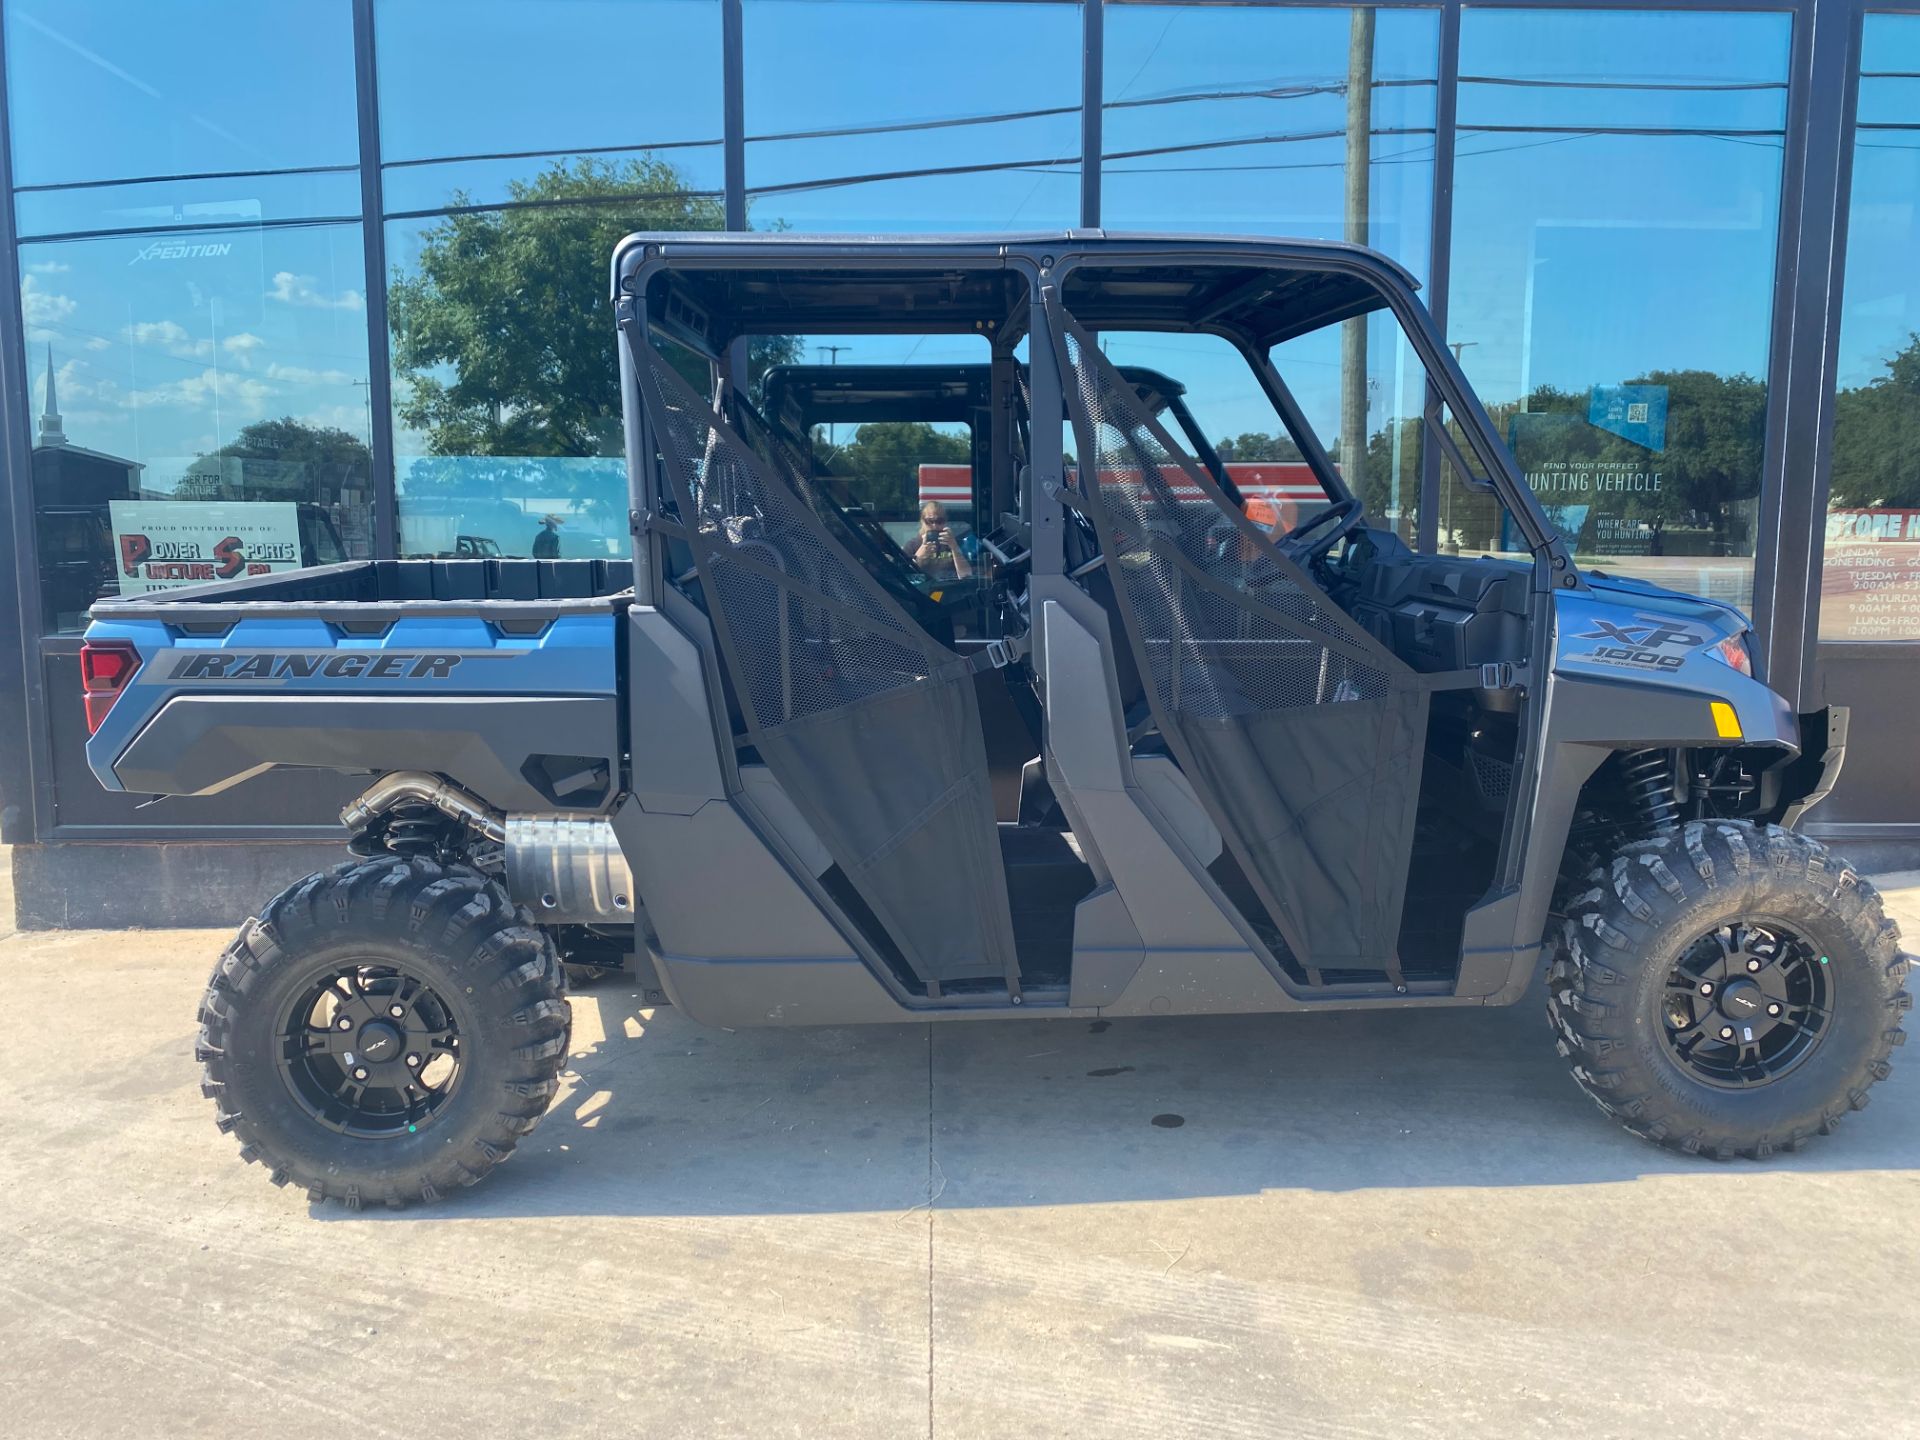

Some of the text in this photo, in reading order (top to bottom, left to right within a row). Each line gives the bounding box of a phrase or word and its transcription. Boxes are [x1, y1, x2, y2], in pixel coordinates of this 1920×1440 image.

[128, 241, 231, 265] XPEDITION
[1596, 472, 1663, 491] VEHICLE
[1597, 519, 1625, 529] WHERE
[1597, 529, 1655, 540] YOU HUNTING?
[1835, 547, 1882, 557] SUNDAY
[1855, 557, 1895, 567] RIDING
[1848, 571, 1901, 581] TUESDAY
[1866, 594, 1920, 603] SATURDA
[1570, 618, 1705, 648] XP
[1595, 647, 1686, 668] 1000
[174, 653, 462, 679] RANGER
